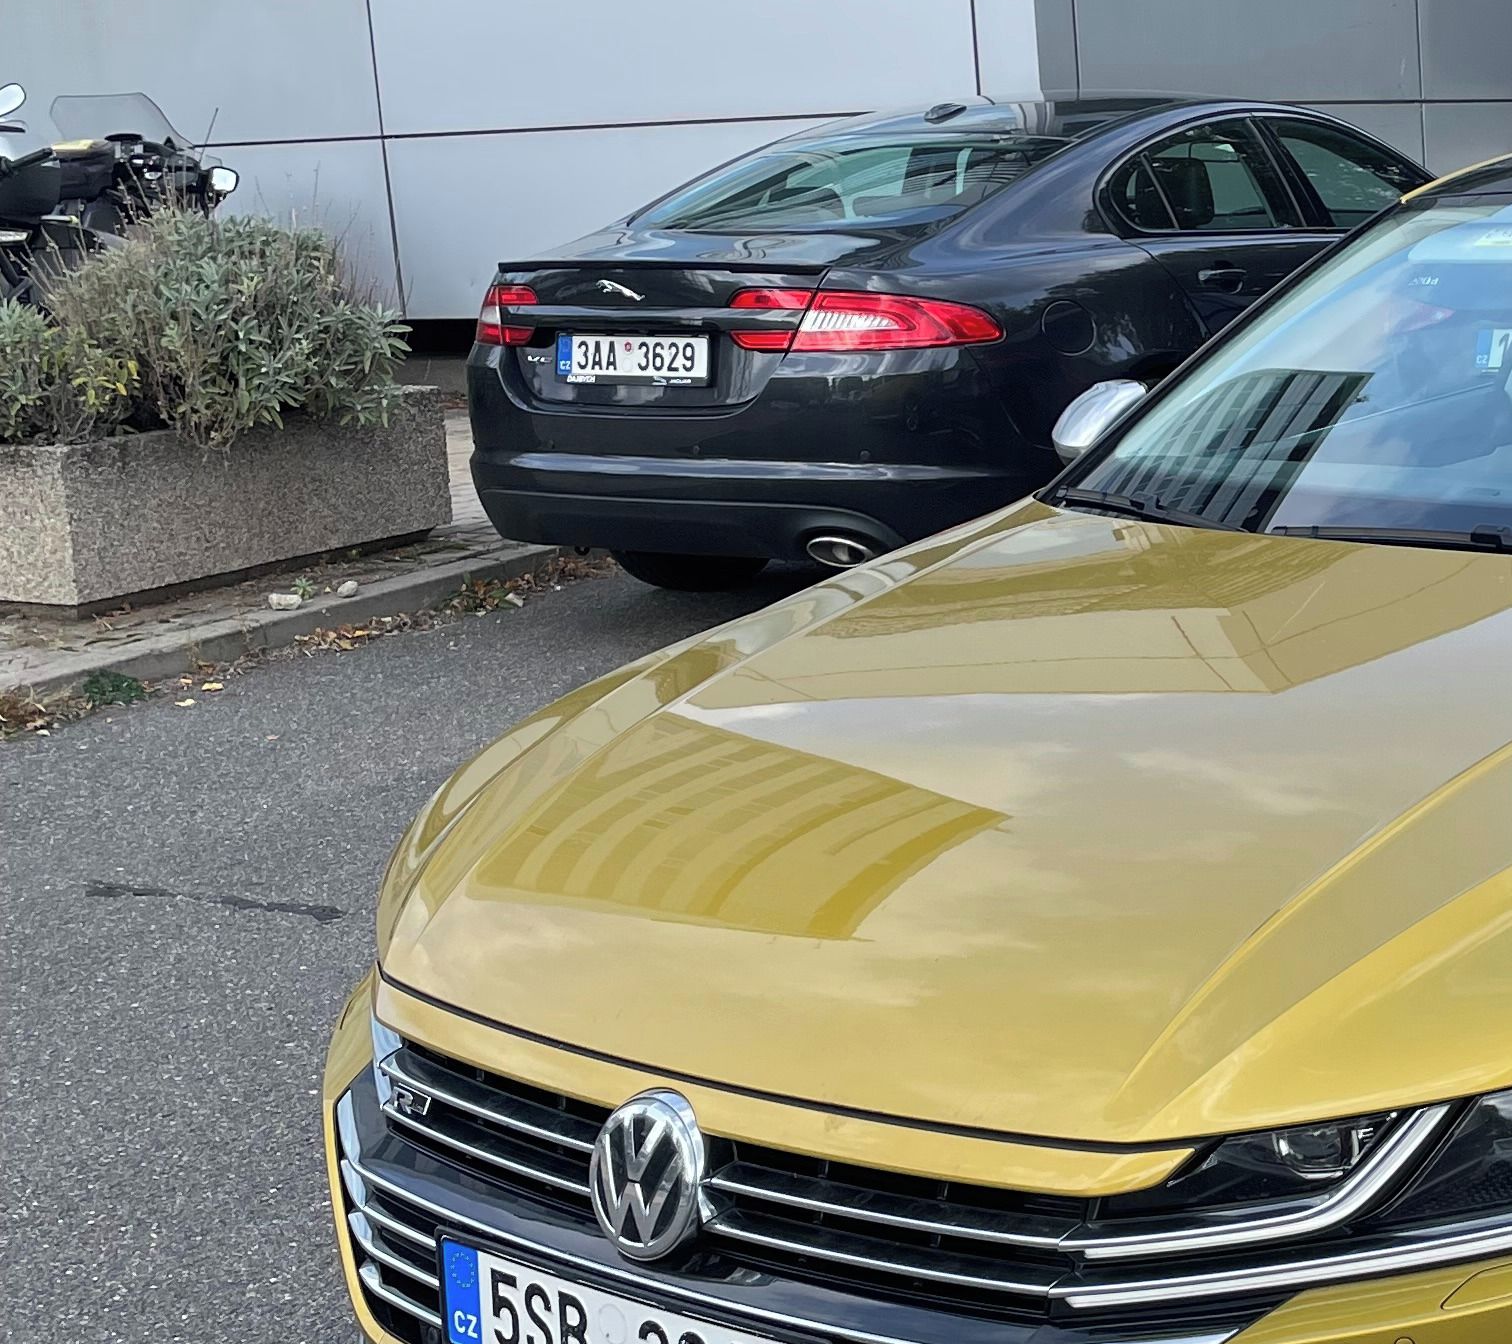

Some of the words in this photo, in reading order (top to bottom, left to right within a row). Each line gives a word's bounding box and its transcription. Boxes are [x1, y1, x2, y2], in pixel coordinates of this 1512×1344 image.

[559, 360, 571, 370] CZ
[577, 340, 618, 371] 3AA
[637, 342, 696, 372] 3629
[453, 1310, 479, 1339] CZ
